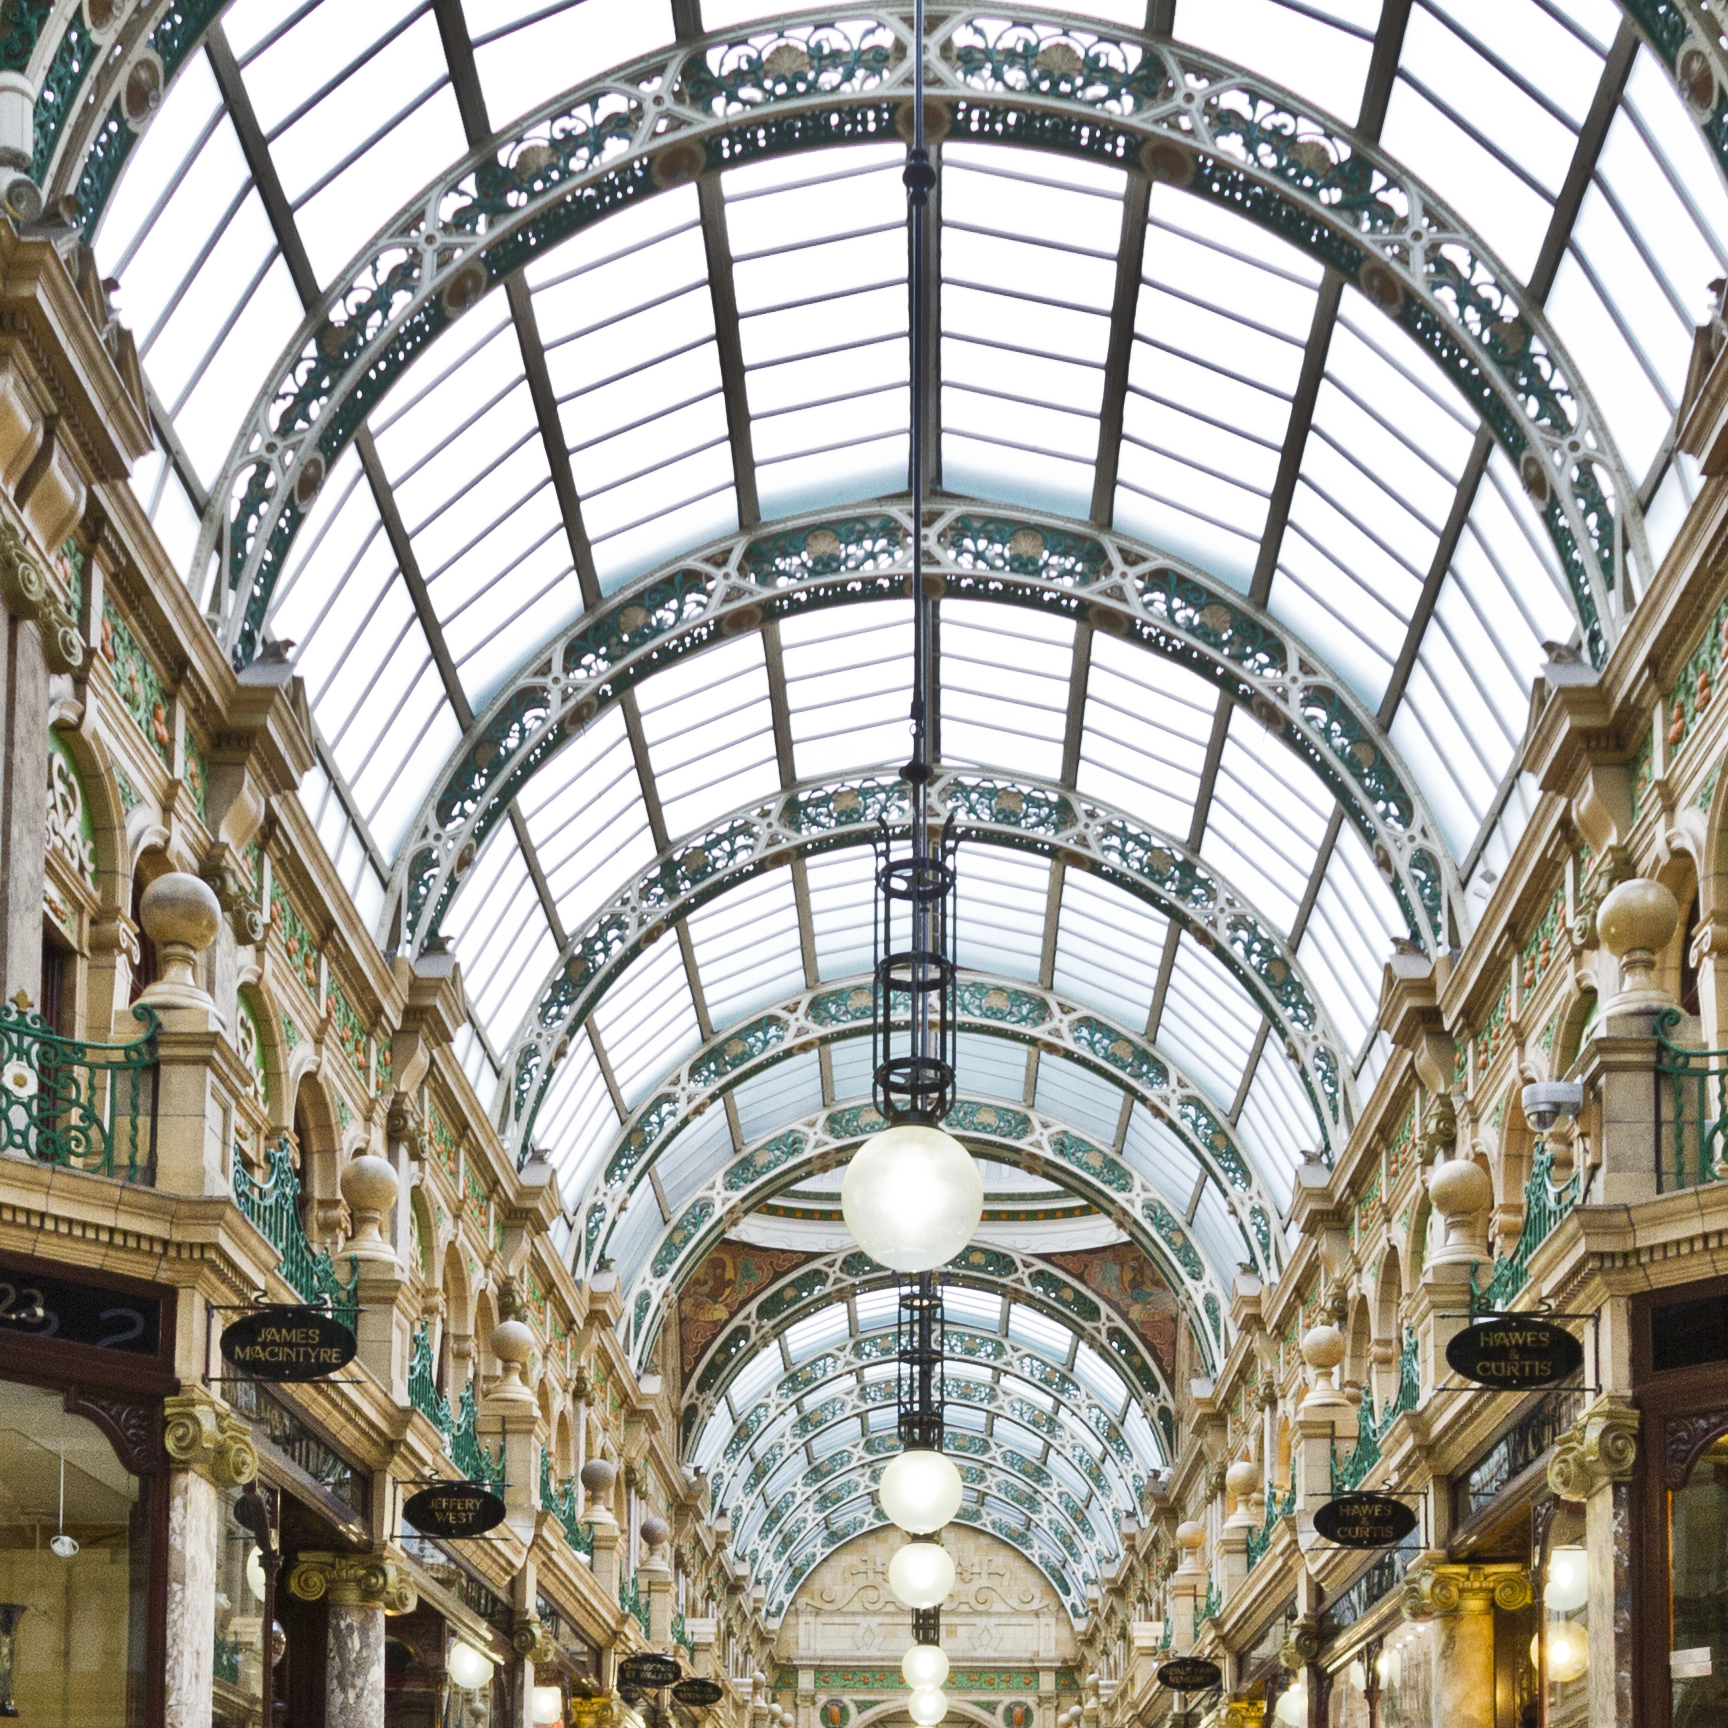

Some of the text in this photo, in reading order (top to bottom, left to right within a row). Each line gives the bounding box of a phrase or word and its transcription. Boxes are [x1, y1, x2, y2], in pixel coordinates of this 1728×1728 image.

[257, 1327, 320, 1343] JAMES
[1480, 1331, 1551, 1348] HAWES
[234, 1345, 342, 1364] MACINTYRE
[1509, 1349, 1520, 1360] &
[1477, 1361, 1552, 1377] CURTIS
[428, 1498, 484, 1512] JEFFERY
[1339, 1504, 1392, 1517] HAWES
[435, 1512, 477, 1525] WEST
[1337, 1526, 1394, 1539] CURTIS
